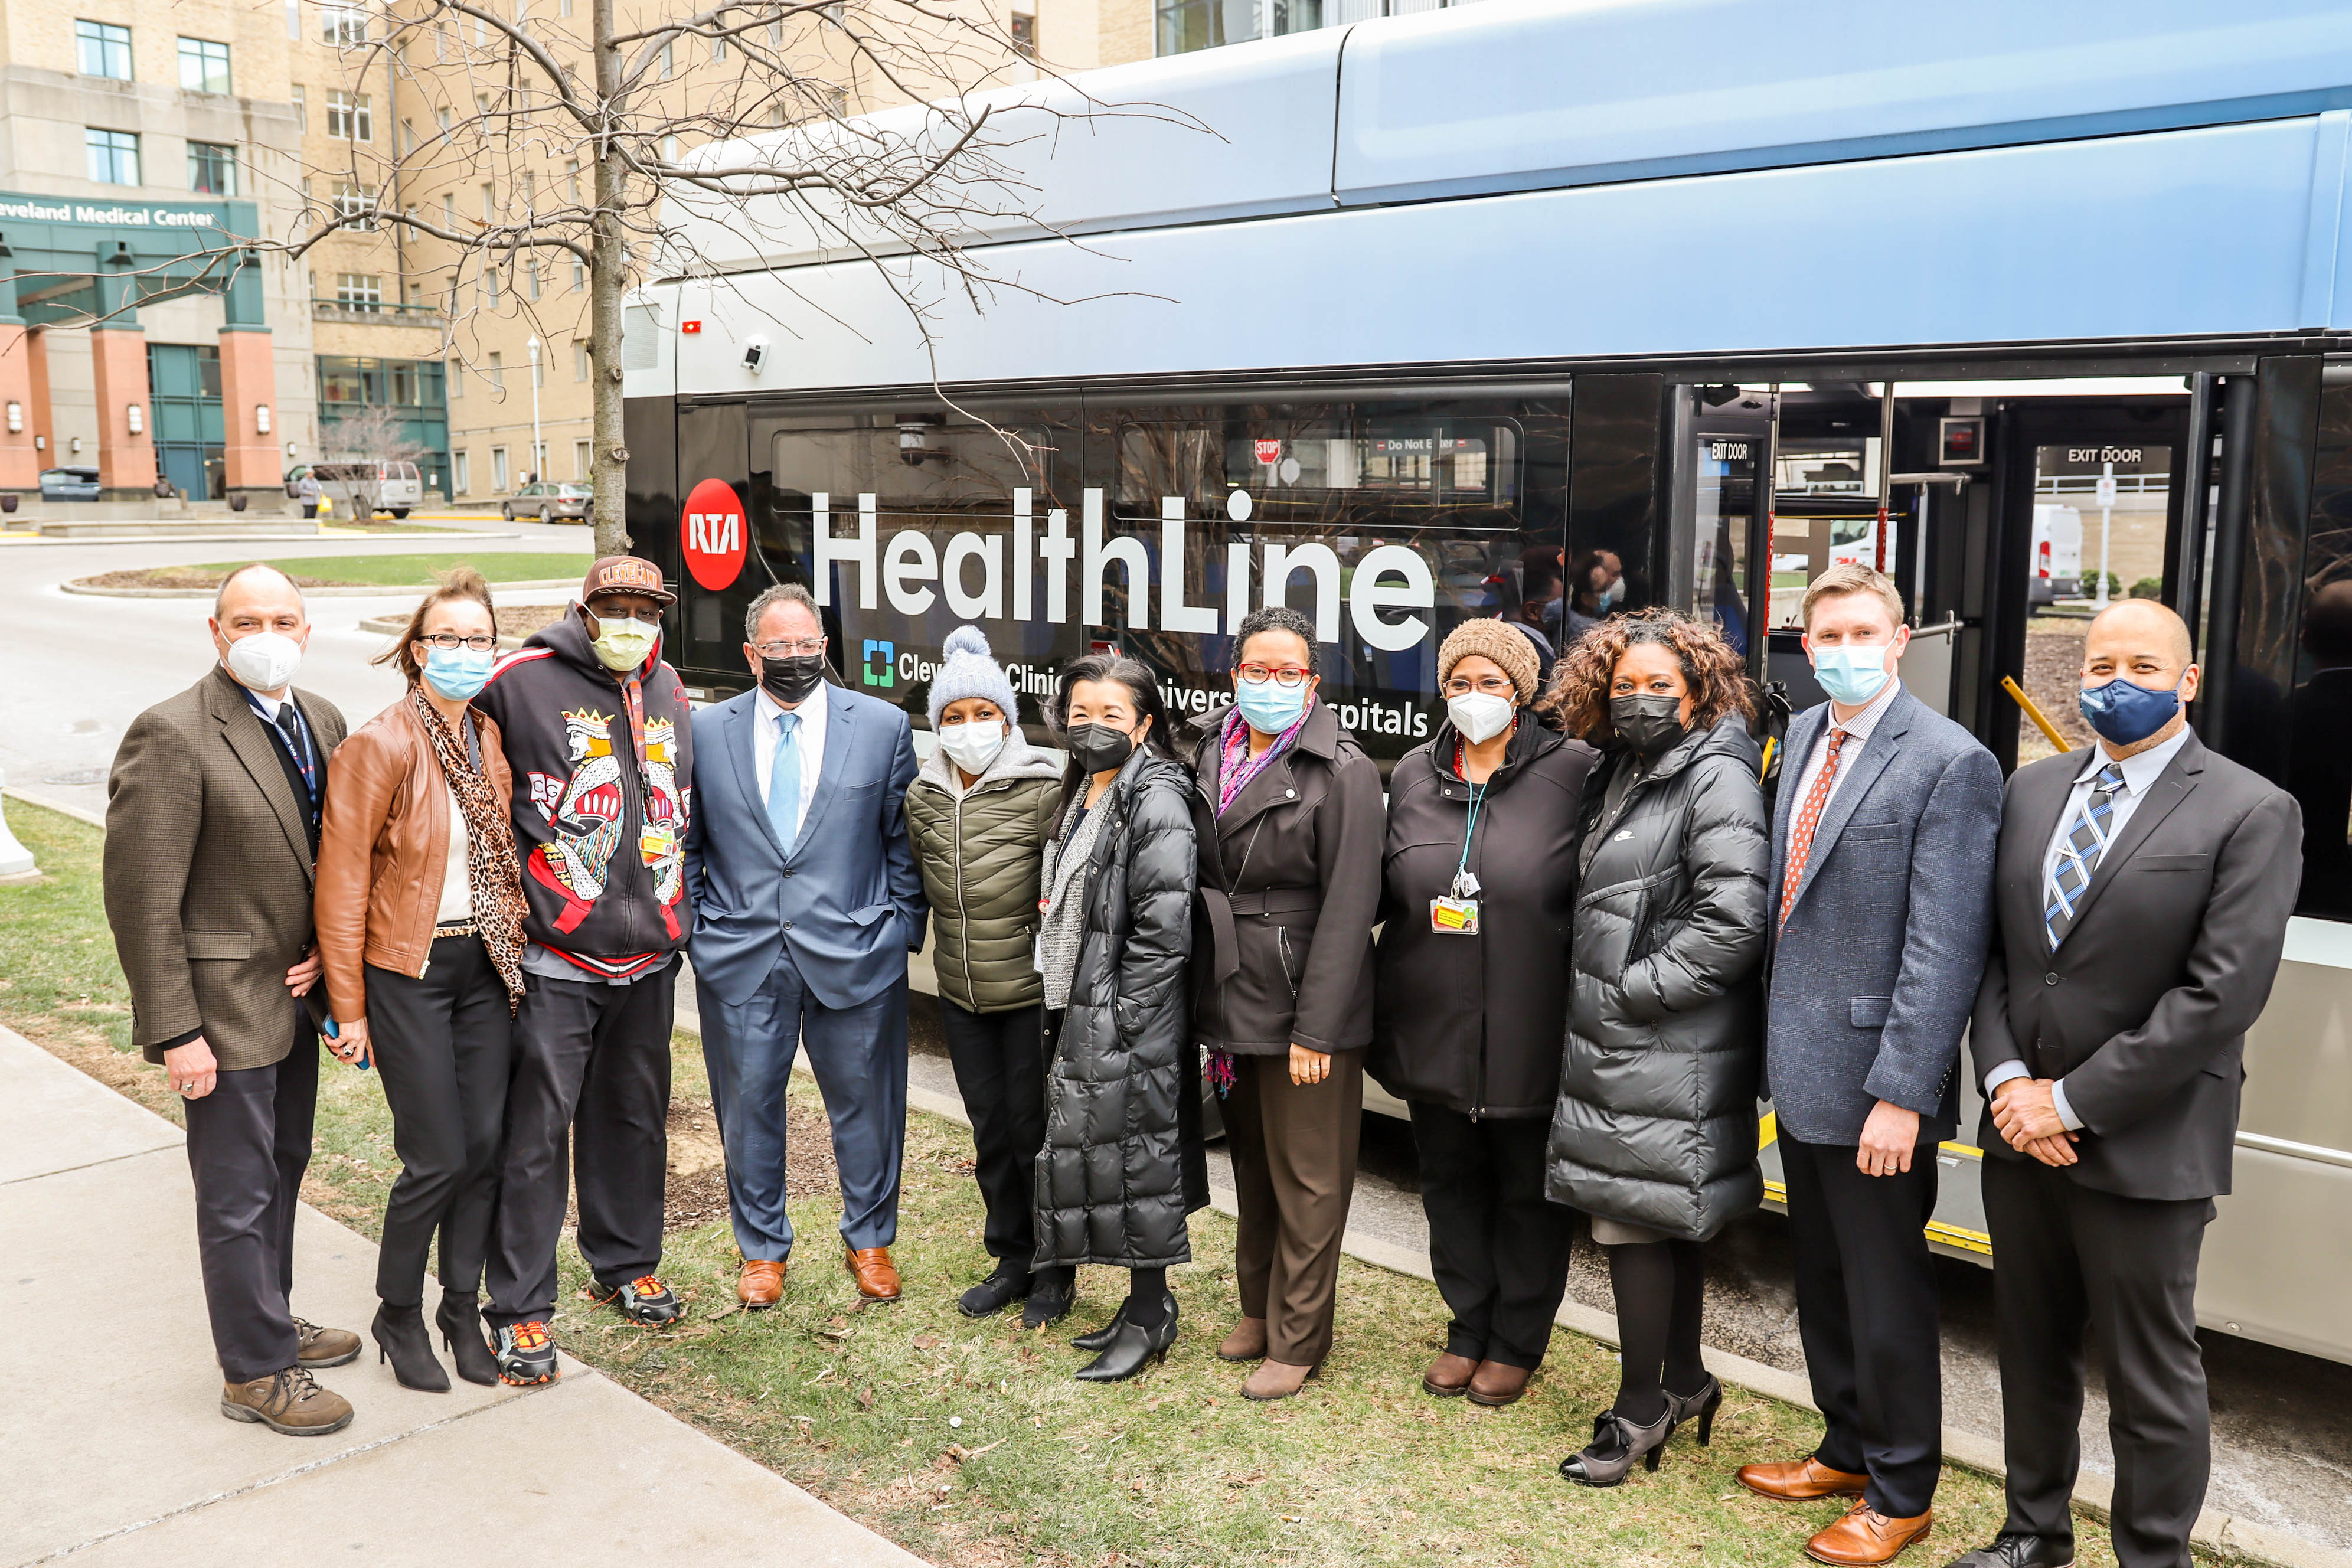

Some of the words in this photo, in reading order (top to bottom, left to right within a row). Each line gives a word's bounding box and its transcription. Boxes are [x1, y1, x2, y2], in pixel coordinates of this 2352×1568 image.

[0, 202, 71, 221] eveland
[76, 206, 149, 225] Medical
[153, 210, 215, 226] Center
[1256, 441, 1278, 454] STOP
[1388, 441, 1403, 450] Do
[1405, 439, 1423, 449] Not
[1426, 439, 1454, 449] Eter
[1712, 443, 1727, 459] EXIT
[1728, 443, 1747, 459] DOOR
[2068, 449, 2098, 462] EXIT
[2101, 449, 2141, 462] DOOR
[689, 514, 739, 554] RTA
[812, 487, 1435, 651] HealthLine
[1157, 678, 1233, 712] ivers
[289, 744, 297, 757] OUR
